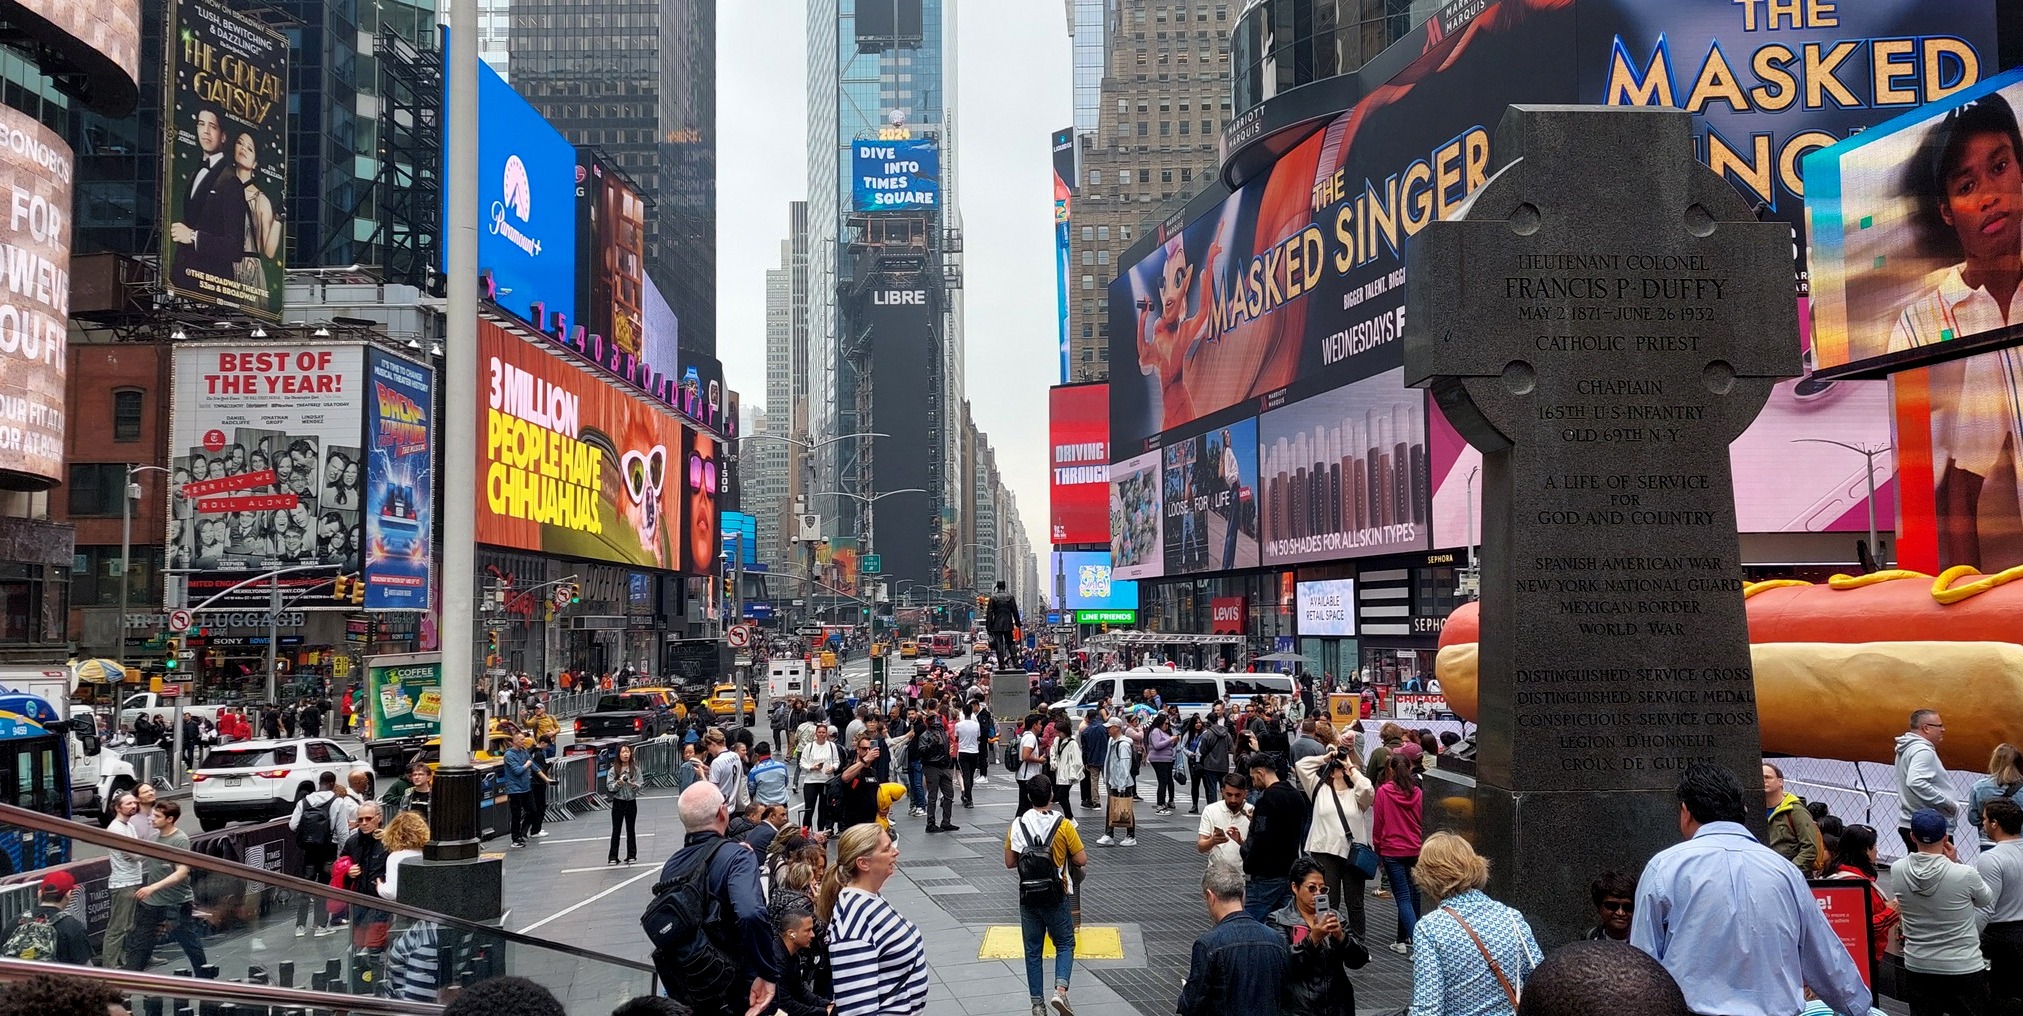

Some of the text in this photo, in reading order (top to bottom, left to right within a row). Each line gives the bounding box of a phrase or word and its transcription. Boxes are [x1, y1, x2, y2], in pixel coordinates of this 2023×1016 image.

[221, 5, 264, 32] ON BROADWAY
[1446, 0, 1485, 34] MARQUIS
[1733, 0, 1840, 31] THE
[209, 24, 216, 35] &
[222, 18, 273, 51] BEWITCHING
[184, 37, 217, 75] THE
[221, 54, 283, 103] GREAT
[1602, 32, 1982, 114] MASKED
[193, 71, 271, 124] GATSBY
[1228, 105, 1266, 137] MARRIOTT
[879, 128, 911, 140] 2024
[1228, 121, 1261, 150] MARQUIS
[860, 146, 896, 160] DIVE
[884, 161, 919, 175] INTO
[863, 176, 908, 190] TIMES
[874, 191, 934, 205] SQUARE
[1312, 170, 1345, 213] THE
[1334, 125, 1491, 276] SINGER
[11, 184, 62, 252] FOR
[488, 200, 542, 257] Paramount+
[1518, 254, 1710, 271] LIEUTENANT COLONEL
[207, 272, 270, 298] BROADWAY THEATRE
[1207, 222, 1327, 343] MASKED
[1504, 277, 1728, 300] FRANCIS DUFFY
[222, 286, 257, 303] BROADWAY
[874, 290, 926, 305] LIBRE
[1343, 283, 1386, 310] BIGGER TALENT.
[1518, 306, 1715, 321] MAY 2 26 1932
[1322, 317, 1394, 366] WEDNESDAYS
[1535, 335, 1701, 350] CATHOLIC PRIEST
[219, 351, 332, 372] BEST OF
[204, 374, 342, 394] THE YEAR!
[374, 366, 429, 393] MUSICAL THEATER HISTORY
[608, 343, 717, 427] BROADWAY
[1577, 380, 1663, 395] CHAPLAIN
[375, 380, 426, 424] BACK
[490, 356, 579, 439] 3 MILLION
[1539, 405, 1586, 420] 165TH
[390, 420, 427, 446] FUTURE
[1562, 428, 1598, 442] OLD
[487, 407, 603, 492] PEOPLE HAVE
[1055, 442, 1104, 463] DRIVING
[184, 473, 271, 495] MERRILY WE
[1543, 475, 1710, 489] A LIFE OF SERVICE
[202, 498, 292, 509] ROLL ALONG
[487, 461, 603, 534] CHIHUAHUAS.
[1167, 490, 1231, 518] LOOSE FOR LIFE
[1610, 495, 1641, 506] FOR
[1537, 511, 1717, 525] GOD AND COUNTRY
[1269, 522, 1416, 558] IN 50 SHADES FOR ALL SKIN TYPES
[1427, 554, 1454, 564] SEPHORA
[1535, 557, 1722, 571] SPANISH AMERICAN WAR
[583, 564, 629, 601] FOREVER
[1516, 578, 1742, 593] NEW YORK NATIONAL GUARD
[1309, 596, 1340, 607] AVAILABLE
[1560, 600, 1701, 615] MEXICAN BORDER
[199, 612, 305, 628] LUGGAGE
[1081, 612, 1132, 621] LINE FRIENDS
[1306, 609, 1345, 621] RETAIL SPACE
[1578, 622, 1685, 637] WORLD WAR
[397, 667, 434, 677] COFFEE
[1516, 668, 1751, 683] DISTINGUISHED SERVICE CROSS
[1396, 695, 1446, 703] CHICAGO
[1516, 690, 1757, 705] DISTINGUISHED SERVICE MEDAL
[1518, 712, 1754, 727] CONSPICUOUS SERVICE CROSS
[1560, 735, 1616, 749] LEGION
[1561, 757, 1645, 771] CROIX DE
[266, 850, 281, 860] TIMES
[264, 860, 282, 870] SQUARE
[89, 888, 109, 900] TIMES
